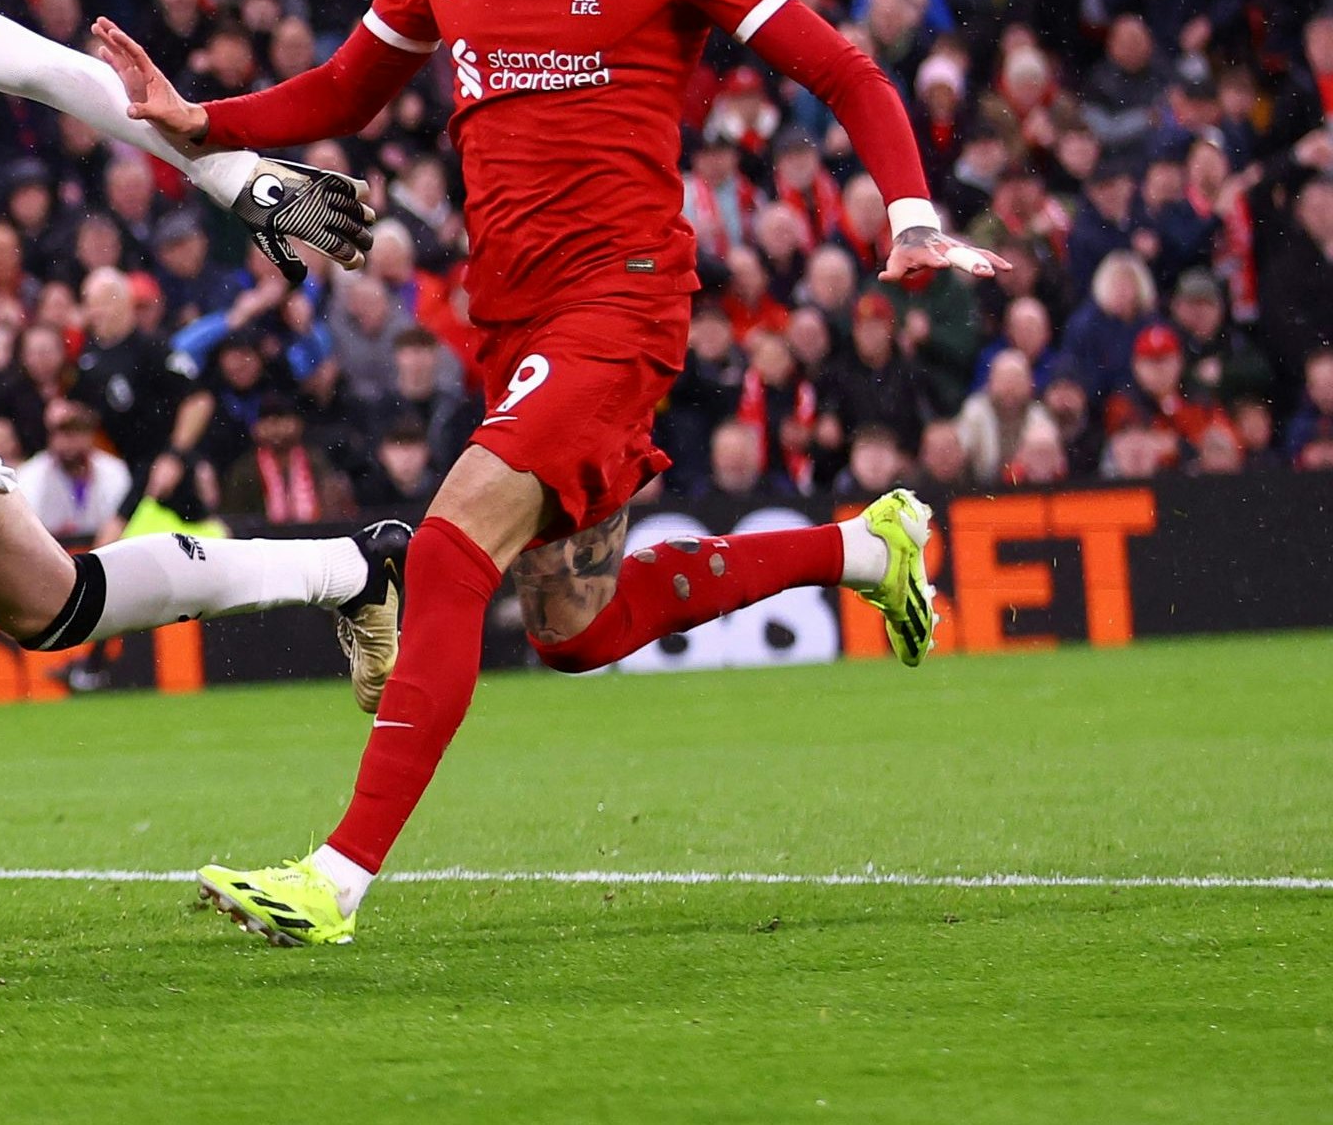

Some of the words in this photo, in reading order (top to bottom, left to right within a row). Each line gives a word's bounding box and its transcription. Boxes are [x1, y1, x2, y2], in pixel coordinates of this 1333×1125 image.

[487, 48, 601, 71] standard
[489, 67, 610, 91] chartered
[255, 231, 281, 264] uhlsport
[495, 353, 550, 413] 9
